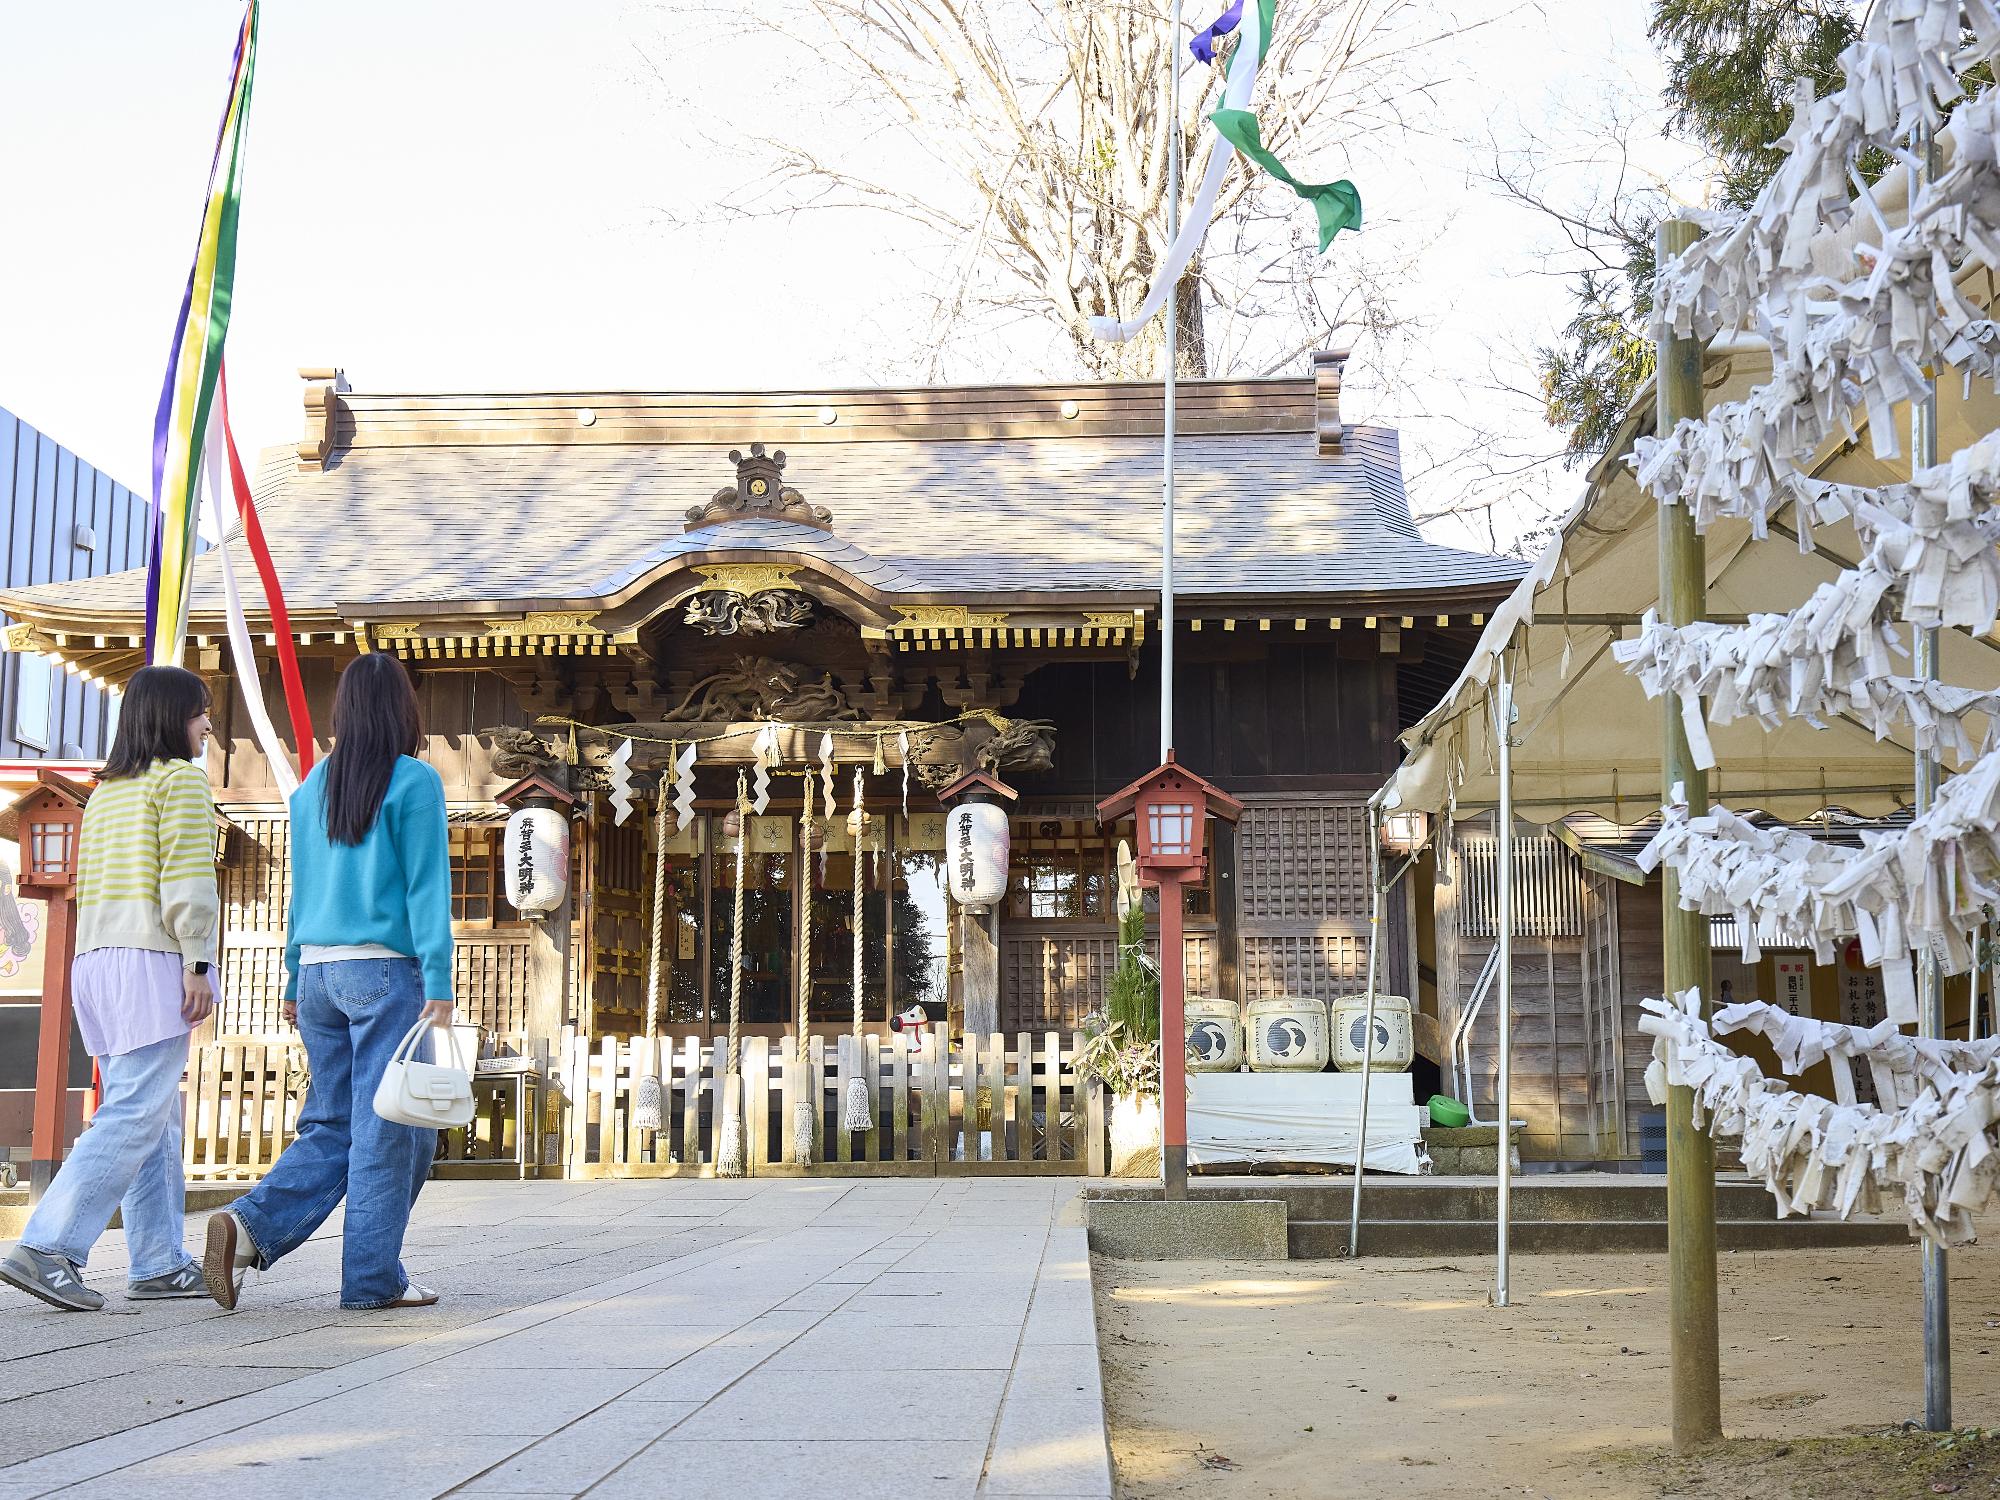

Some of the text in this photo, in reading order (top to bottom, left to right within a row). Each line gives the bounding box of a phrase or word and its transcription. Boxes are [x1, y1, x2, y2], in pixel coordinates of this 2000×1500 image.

[518, 817, 535, 895] 麻賀多大明神
[958, 812, 976, 892] 麻賀多大明神
[46, 1269, 73, 1289] N
[172, 1272, 196, 1289] N
